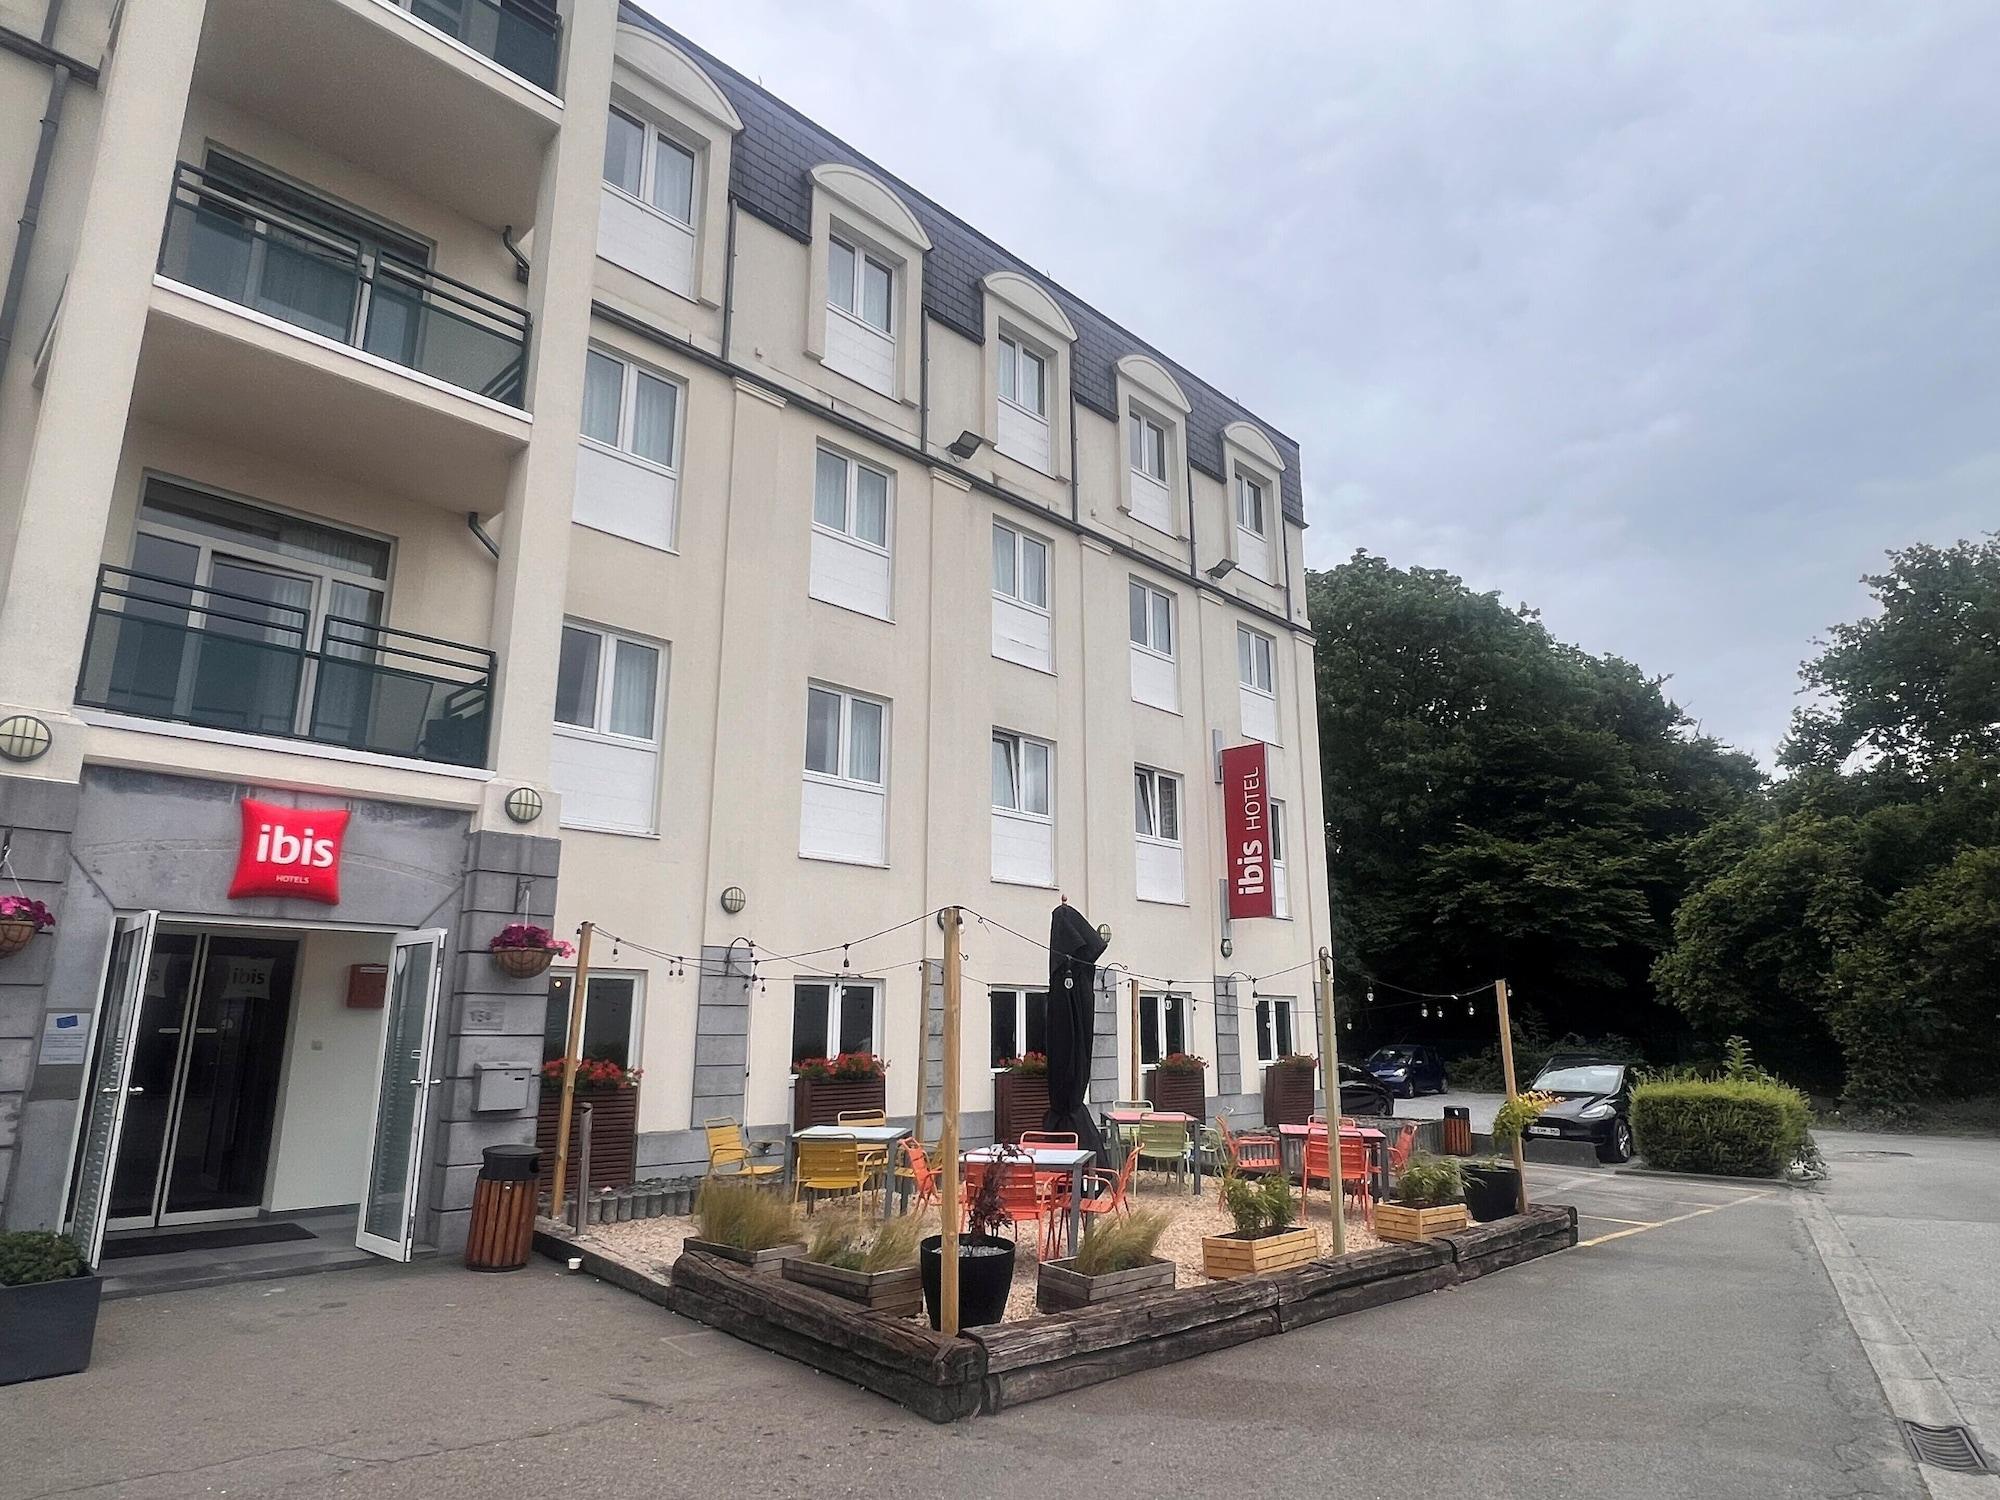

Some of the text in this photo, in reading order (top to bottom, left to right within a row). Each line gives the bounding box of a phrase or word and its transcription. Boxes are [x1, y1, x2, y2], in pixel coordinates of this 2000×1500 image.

[256, 824, 334, 868] ibis
[1236, 767, 1264, 895] ibis HOTEL
[275, 874, 310, 884] HOTELS
[232, 967, 265, 985] ibis
